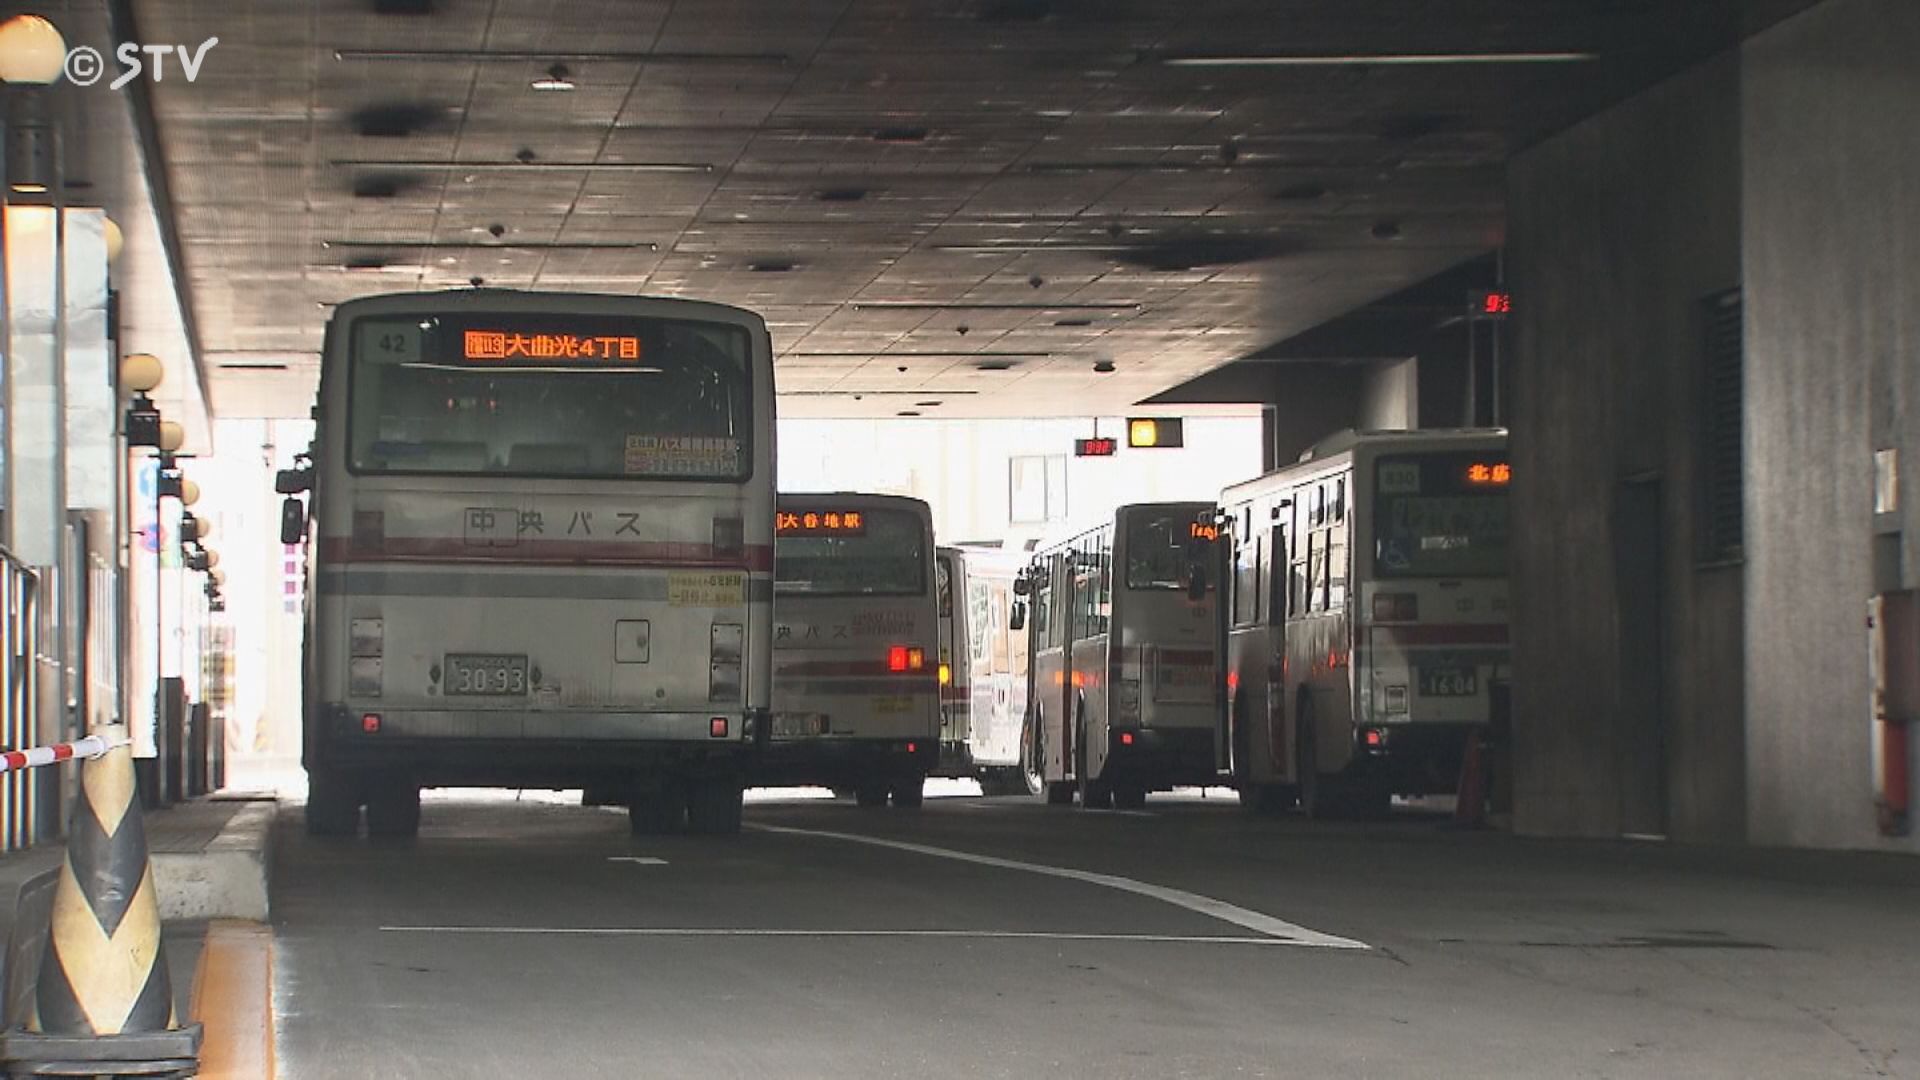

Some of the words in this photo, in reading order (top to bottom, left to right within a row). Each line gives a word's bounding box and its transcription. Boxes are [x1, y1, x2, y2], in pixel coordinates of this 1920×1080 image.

[378, 335, 406, 353] 42
[505, 333, 639, 359] 大曲光4丁目
[470, 510, 642, 536] 中央バス
[458, 668, 524, 693] 30-93
